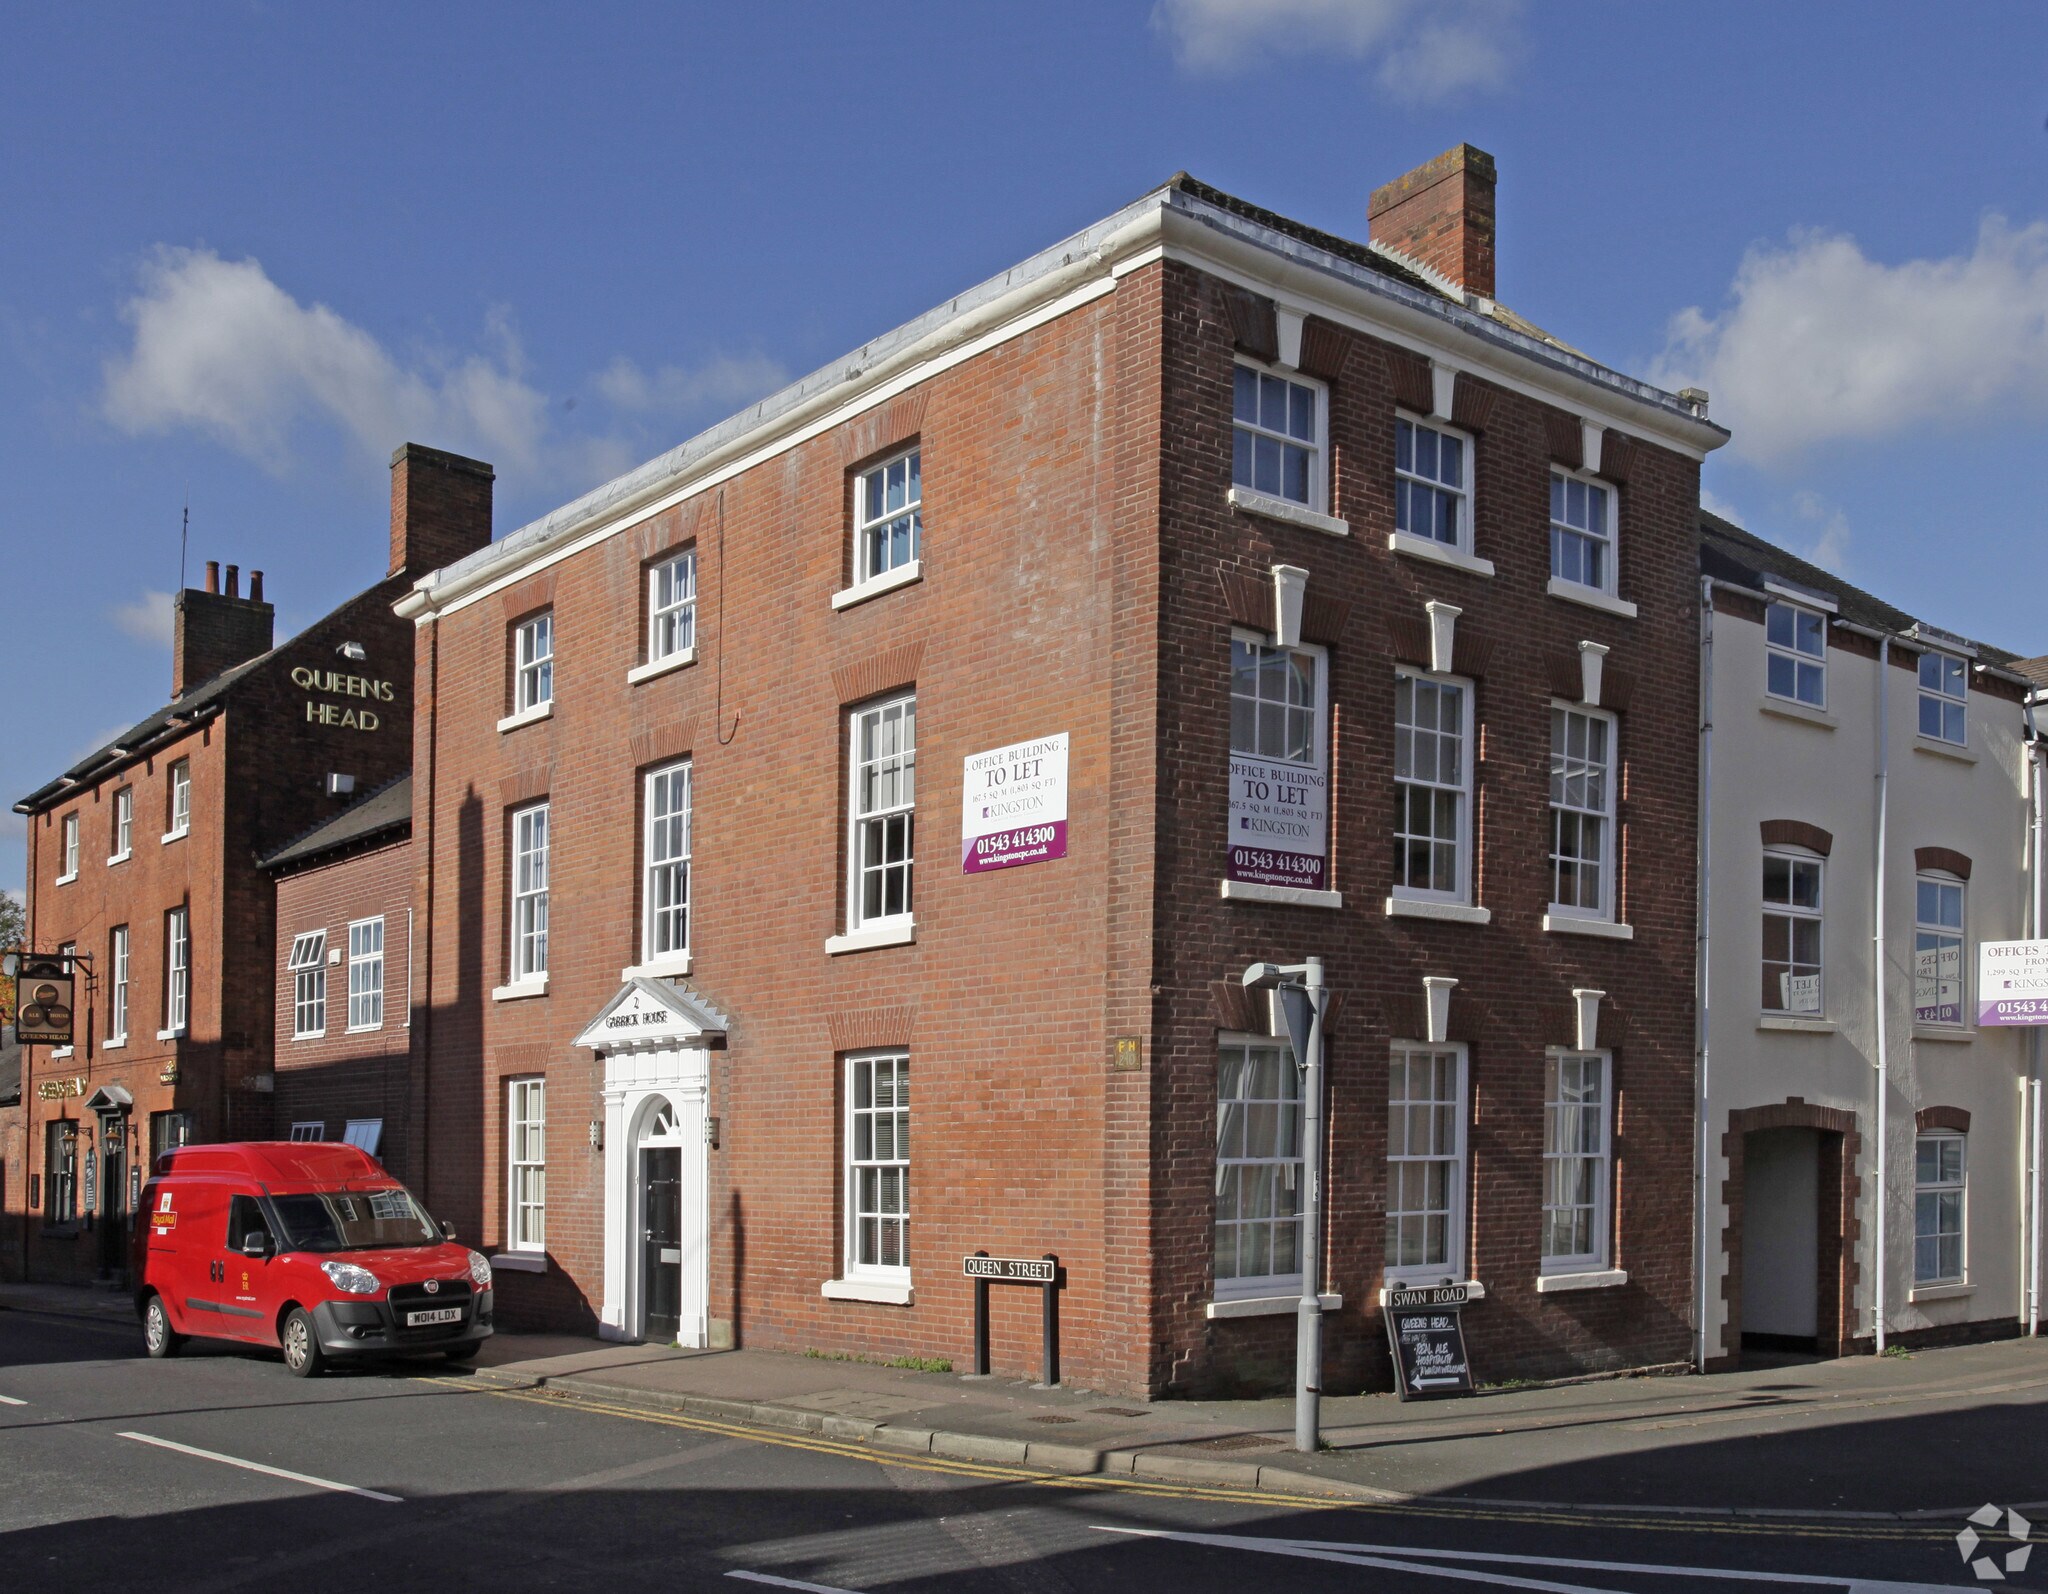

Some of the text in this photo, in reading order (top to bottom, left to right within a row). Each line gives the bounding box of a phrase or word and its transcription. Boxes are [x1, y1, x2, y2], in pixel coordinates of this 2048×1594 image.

[291, 667, 394, 702] QUEENS
[307, 701, 379, 731] HEAD
[972, 740, 1059, 771] OFFICE BUILDING
[985, 758, 1043, 787] TO LET
[1228, 763, 1325, 787] OFFICE BUILDING
[989, 790, 998, 800] SQ
[1001, 788, 1007, 796] M
[1031, 780, 1041, 790] SQ
[1044, 777, 1057, 787] FT)
[1243, 780, 1309, 806] TO LET
[990, 795, 1044, 817] KINGSTON
[1249, 803, 1260, 813] SQ
[1263, 805, 1270, 813] M
[1297, 809, 1307, 820] SQ
[1311, 811, 1323, 821] FT)
[1251, 818, 1310, 837] KINGSTON
[977, 826, 1055, 854] 01543 414300
[979, 845, 1047, 865] www.kingstoncpc.co.uk
[1234, 849, 1321, 874] 01543 414300
[1236, 869, 1313, 885] www.kingstoncpc.co.uk
[1988, 946, 2039, 957] OFFICES
[634, 996, 640, 1009] 2
[1997, 1000, 2037, 1014] 01543
[606, 1010, 668, 1029] GARRICK HOUSE
[152, 1213, 175, 1226] Royal Mail
[968, 1260, 1049, 1278] QUEEN STREET
[1394, 1287, 1465, 1306] SWAN ROAD
[438, 1310, 456, 1321] LDX
[1401, 1317, 1427, 1329] QUEENS
